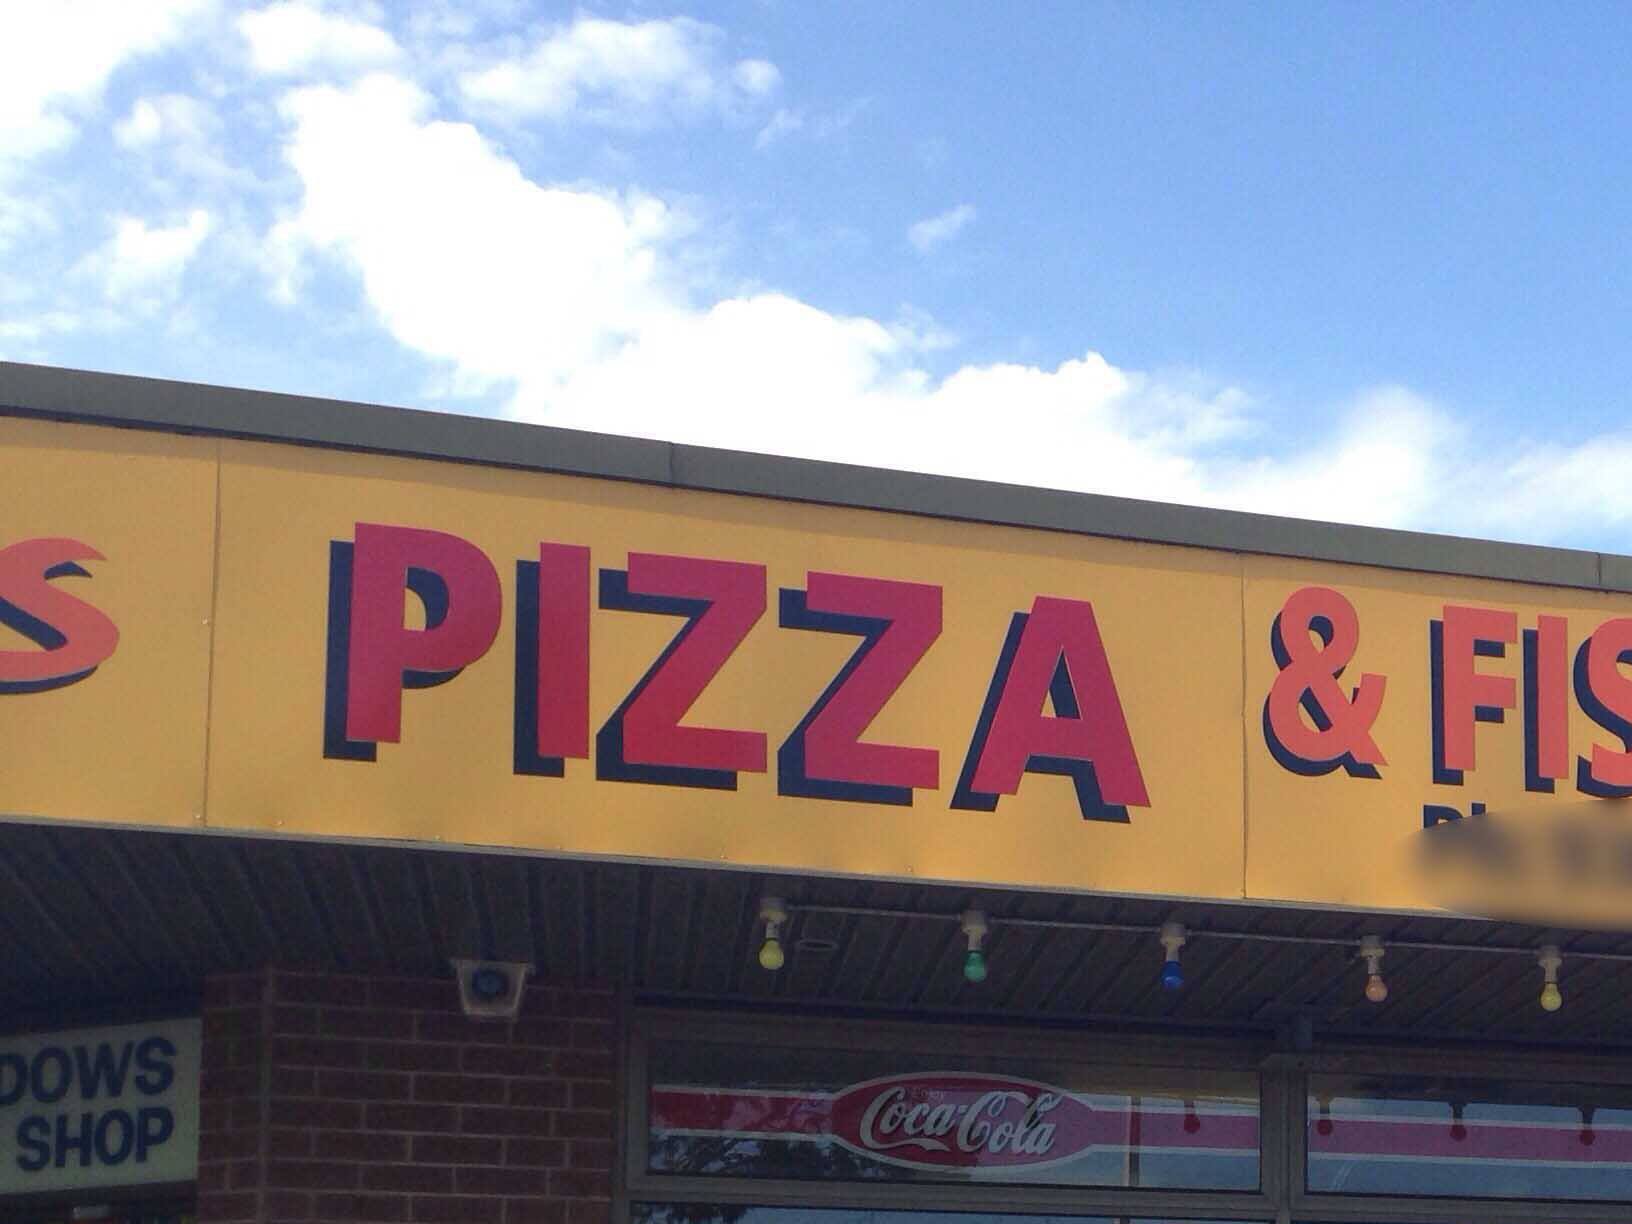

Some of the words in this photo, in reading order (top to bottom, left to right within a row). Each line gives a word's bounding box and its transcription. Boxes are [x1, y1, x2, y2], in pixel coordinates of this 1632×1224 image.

[323, 522, 1151, 824] PIZZA
[1262, 586, 1388, 779] &
[16, 1106, 175, 1172] SHOP
[859, 1086, 1064, 1155] Coca-Cola
